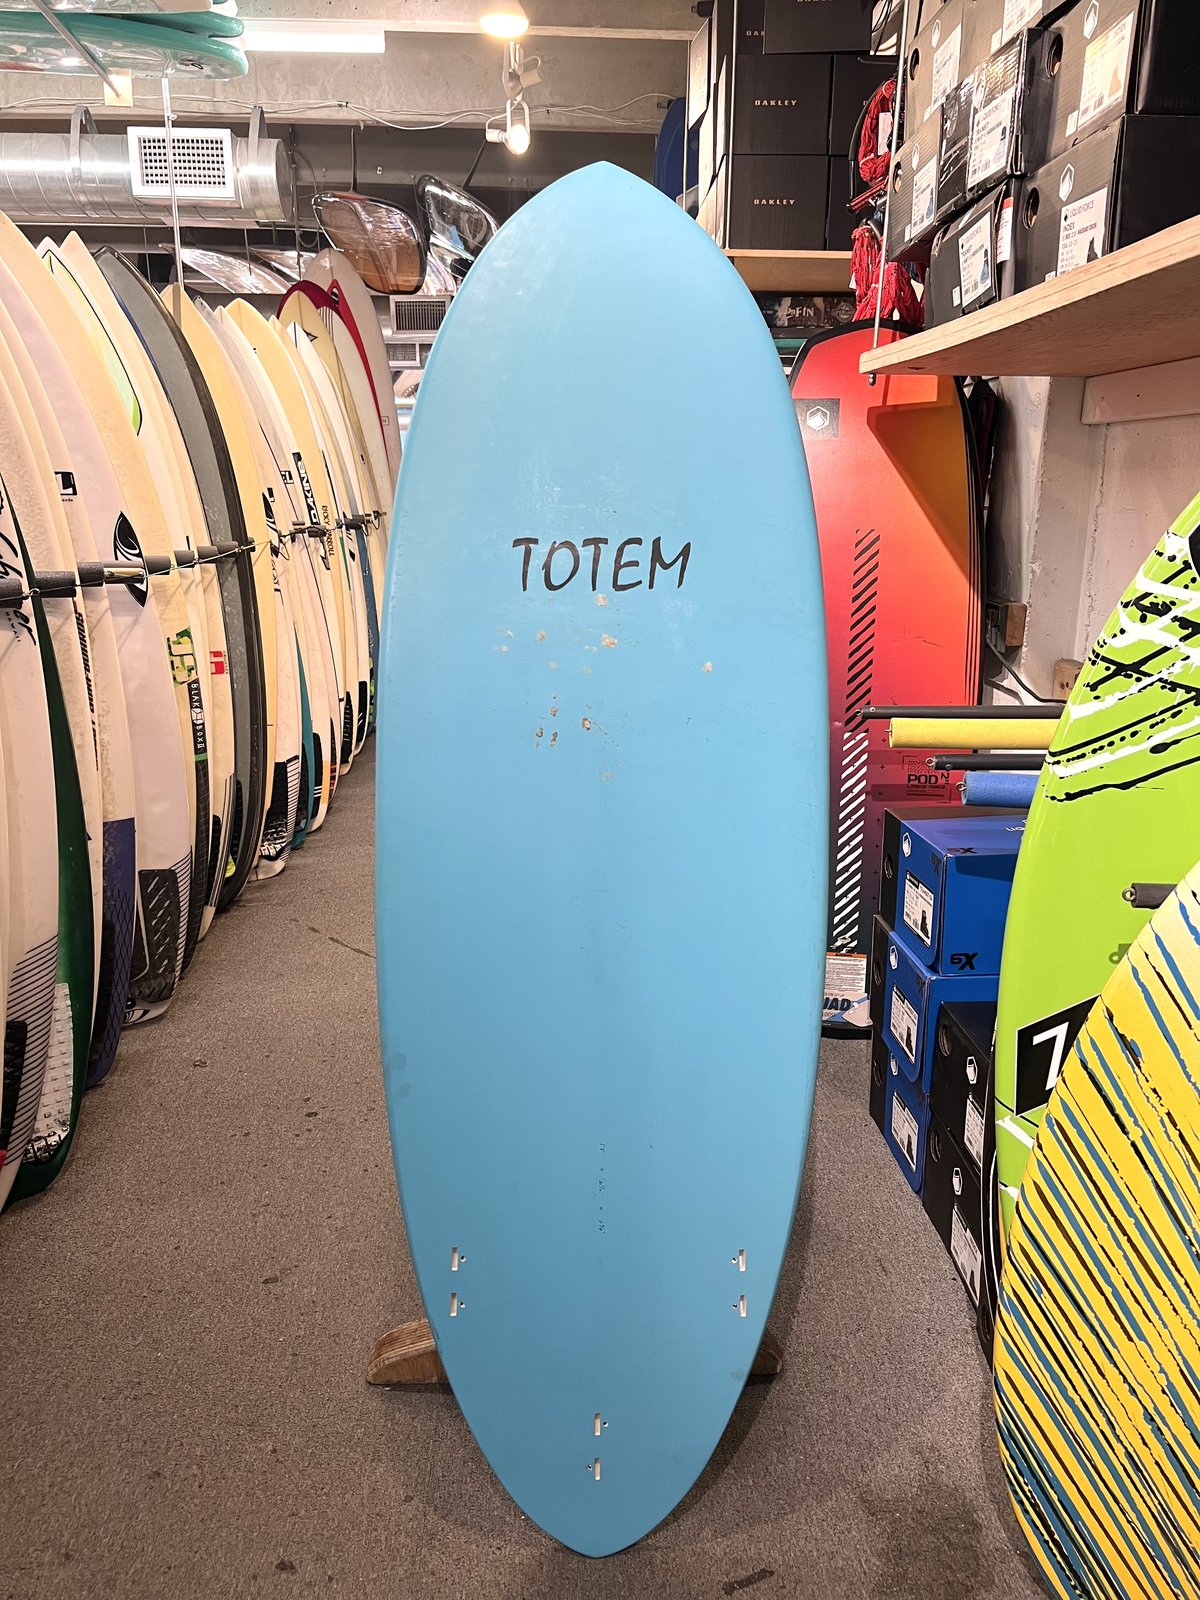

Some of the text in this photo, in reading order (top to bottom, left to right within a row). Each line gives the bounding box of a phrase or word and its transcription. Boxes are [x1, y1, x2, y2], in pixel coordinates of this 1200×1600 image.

[753, 198, 796, 206] OAKLEY
[297, 460, 320, 523] DAKINE
[512, 536, 692, 592] TOTEM
[190, 683, 200, 708] BLAK
[907, 774, 938, 784] POD
[950, 952, 978, 971] 6X
